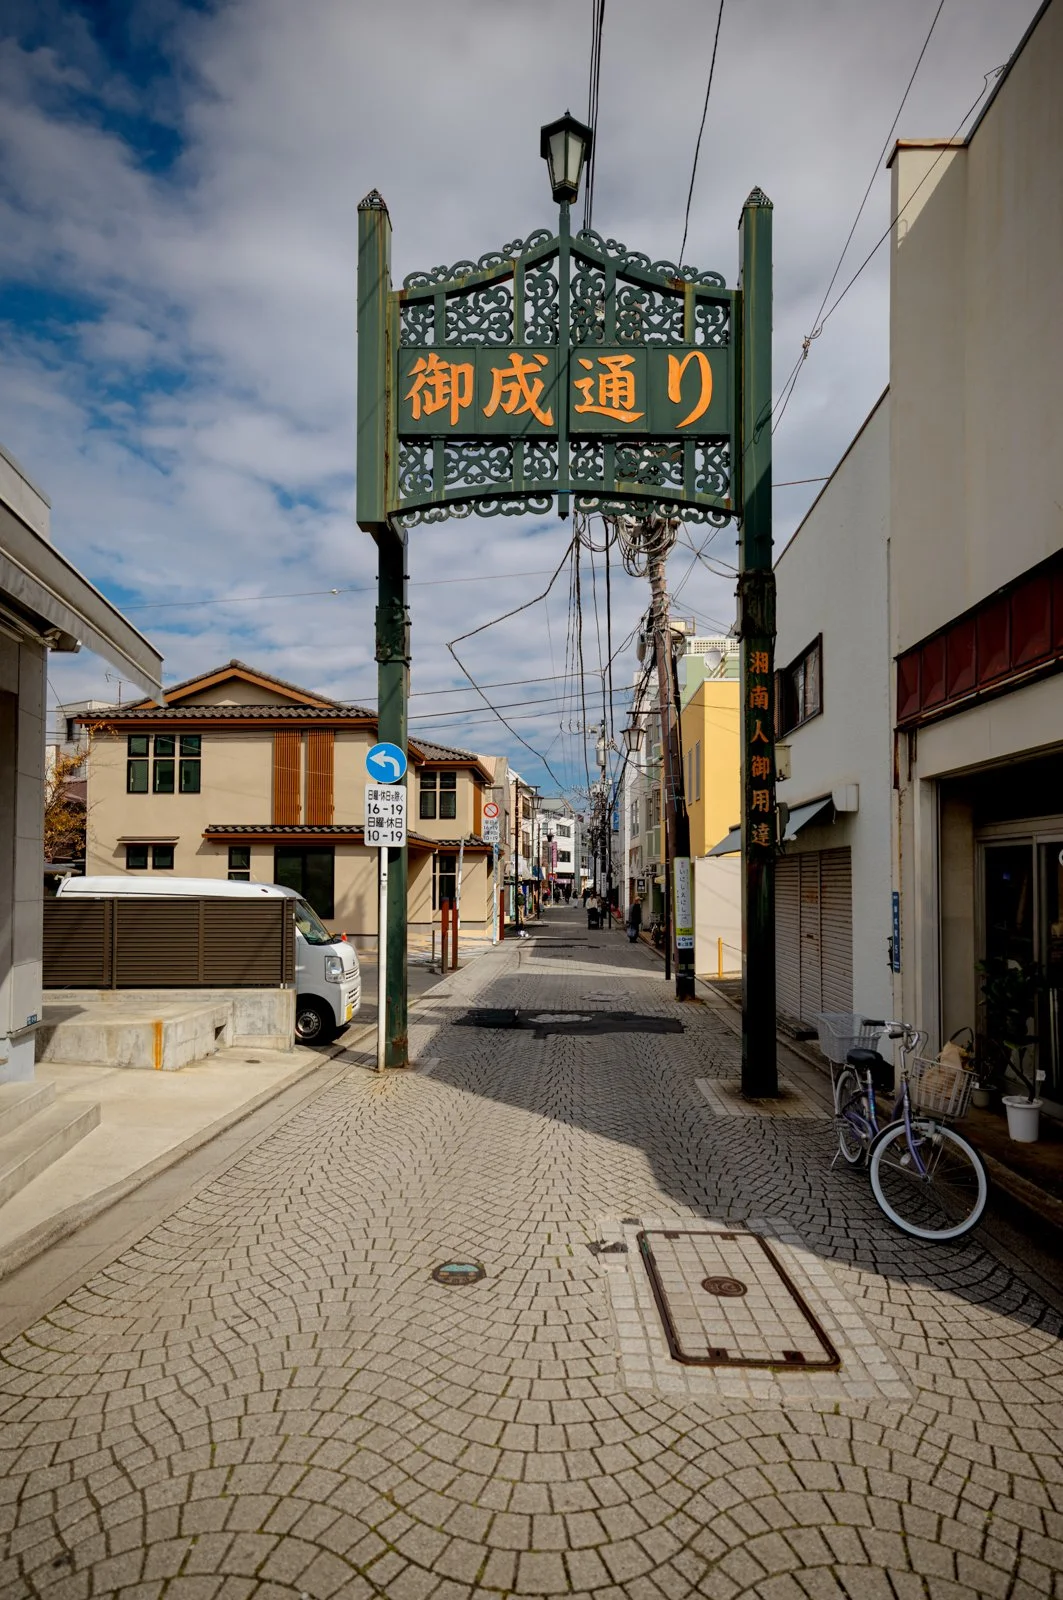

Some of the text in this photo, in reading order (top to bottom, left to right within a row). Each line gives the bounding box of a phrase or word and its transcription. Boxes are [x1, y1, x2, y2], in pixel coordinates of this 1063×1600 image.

[403, 350, 712, 429] 御成通り
[749, 650, 772, 848] 湘南人御用達
[367, 803, 403, 815] 16-19
[367, 817, 403, 829] 日曜・休日
[367, 830, 403, 842] 10-19
